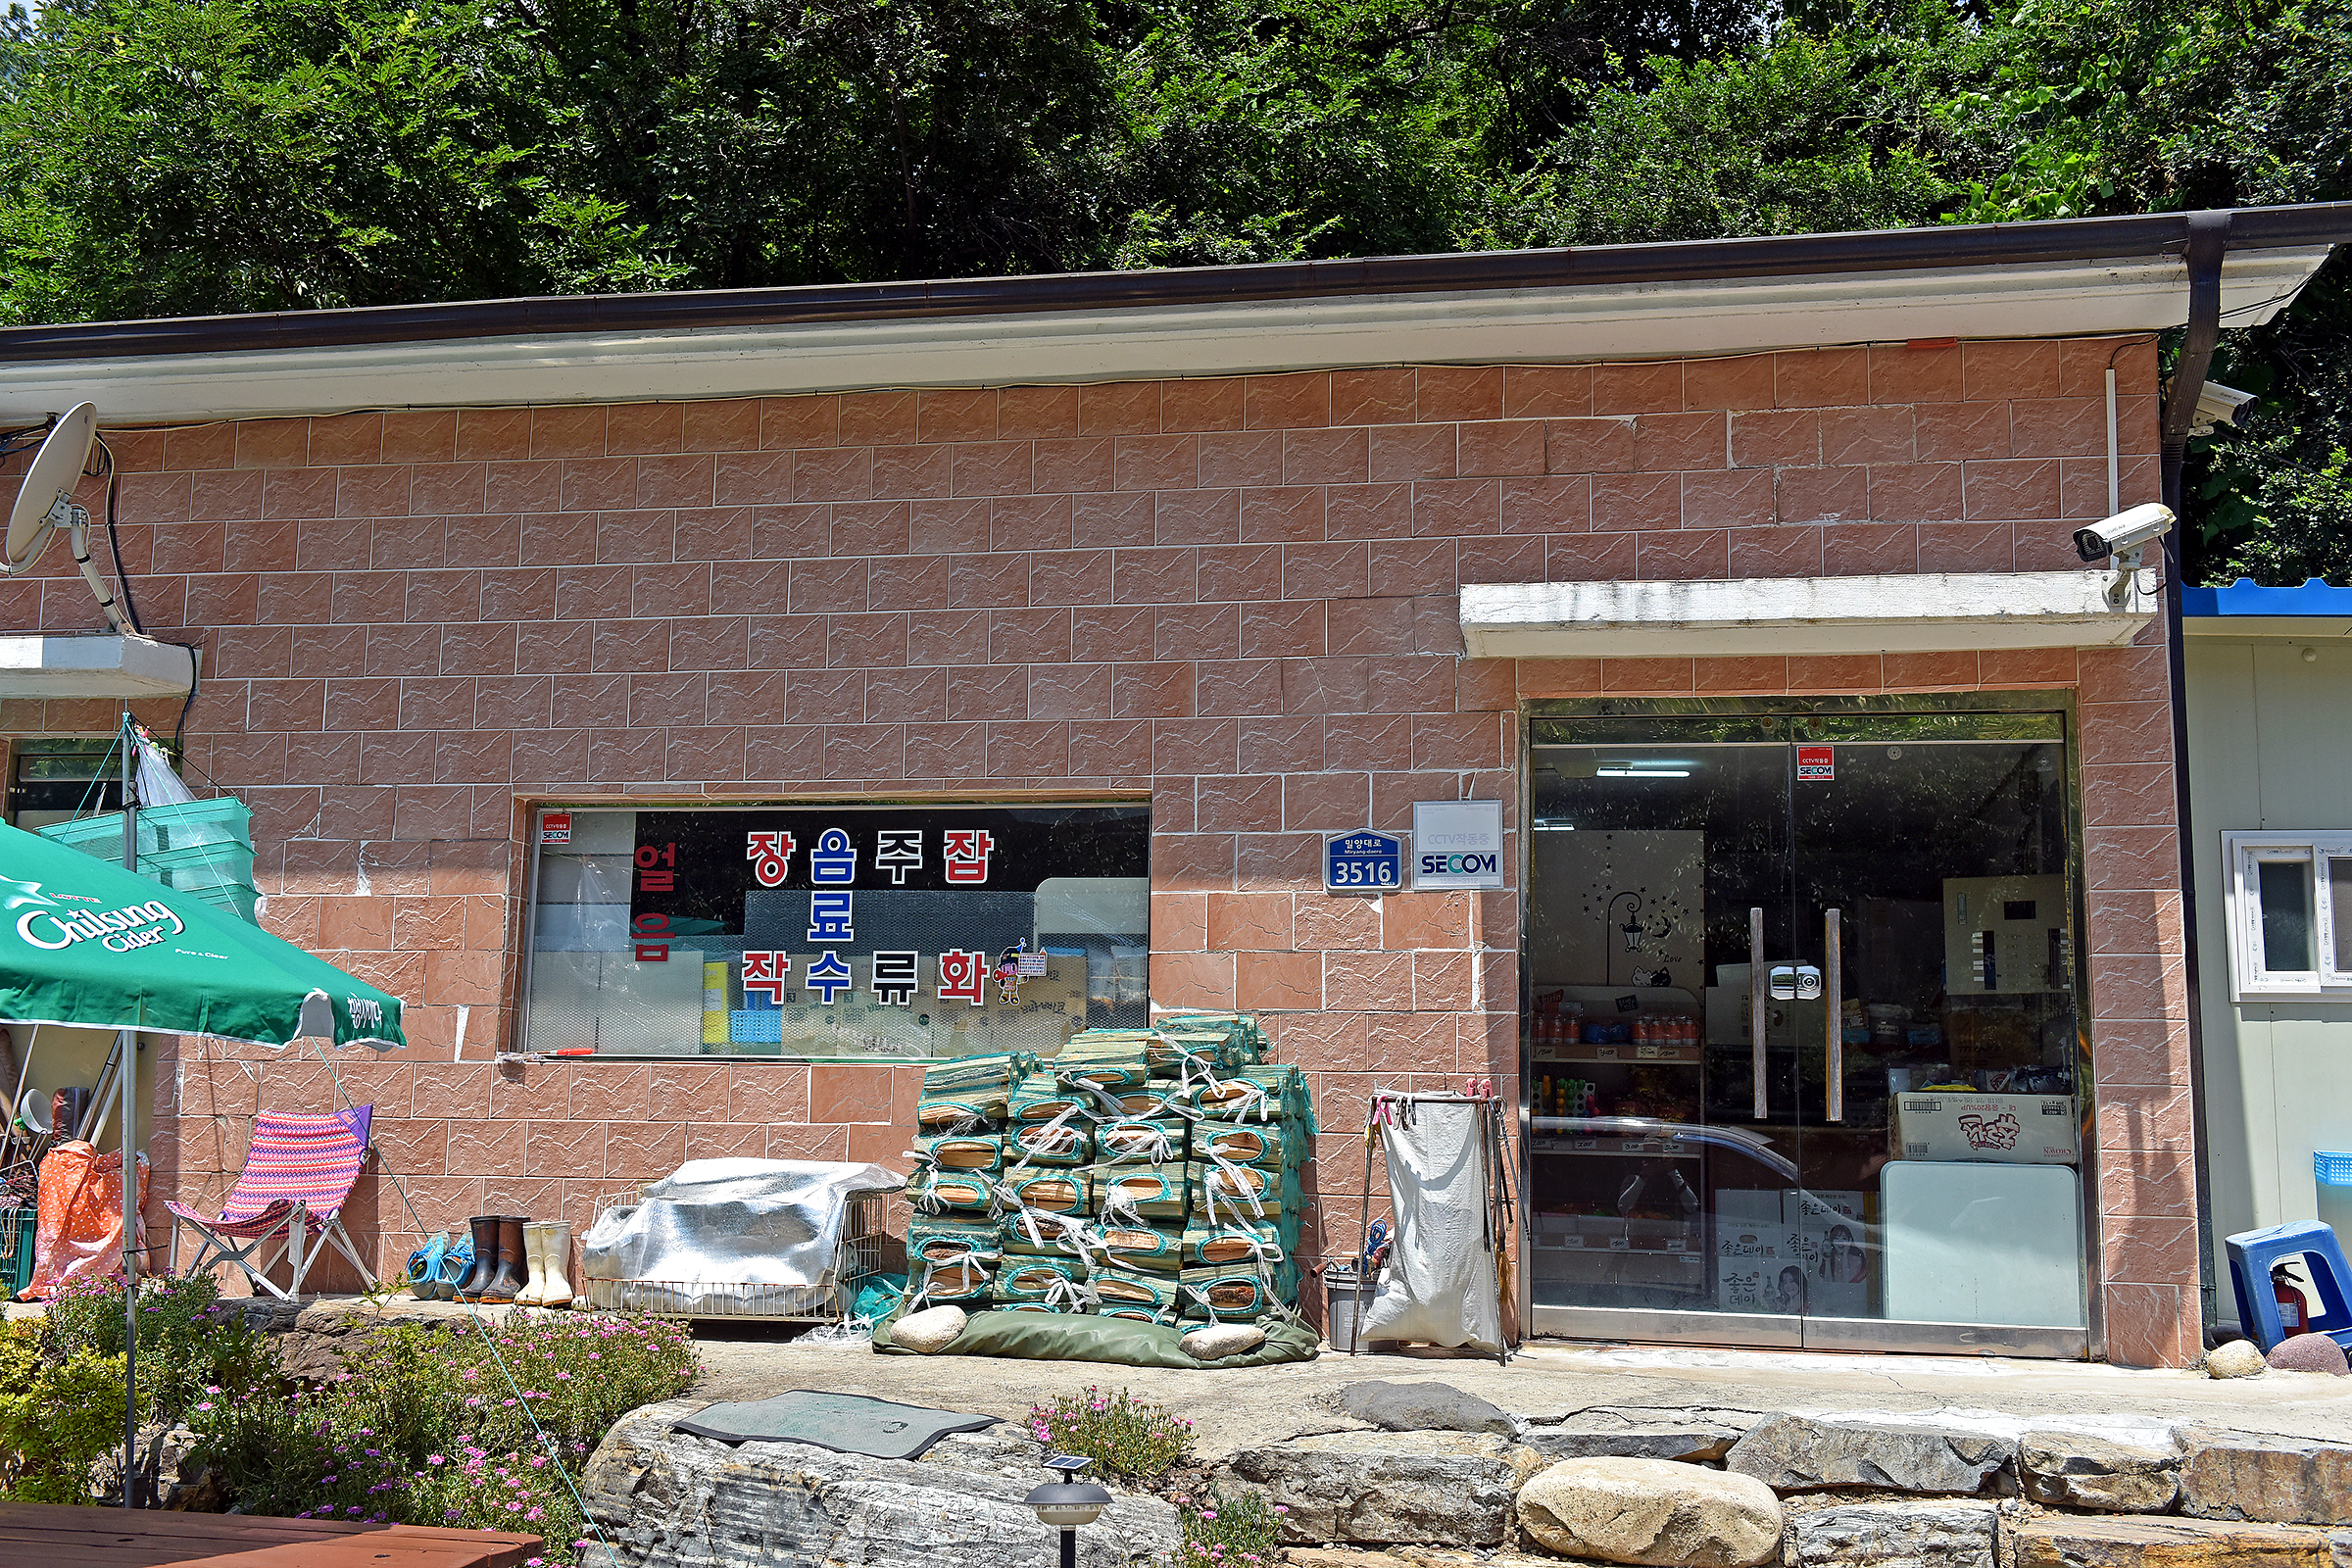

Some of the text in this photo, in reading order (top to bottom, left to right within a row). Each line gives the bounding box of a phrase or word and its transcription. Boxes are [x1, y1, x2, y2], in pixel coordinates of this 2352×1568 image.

[1345, 838, 1383, 849] 밀양대로
[1428, 833, 1490, 846] CCTV작동중
[1336, 861, 1392, 883] 3516
[1421, 854, 1496, 874] SECOM
[49, 892, 102, 904] LOTTE
[633, 842, 676, 961] 얼음
[16, 899, 185, 950] Chilsung
[742, 829, 796, 1004] 장작
[805, 827, 858, 1004] 음료수
[870, 829, 923, 1005] 주류
[937, 829, 994, 1006] 잡화
[101, 925, 168, 953] Cider
[1663, 954, 1683, 963] Love
[2043, 1146, 2072, 1154] CROWN
[1799, 1200, 1841, 1216] 좋은데이
[1721, 1240, 1764, 1256] 좋은데이
[1722, 1272, 1756, 1294] 좋은
[1729, 1295, 1756, 1305] 데이
